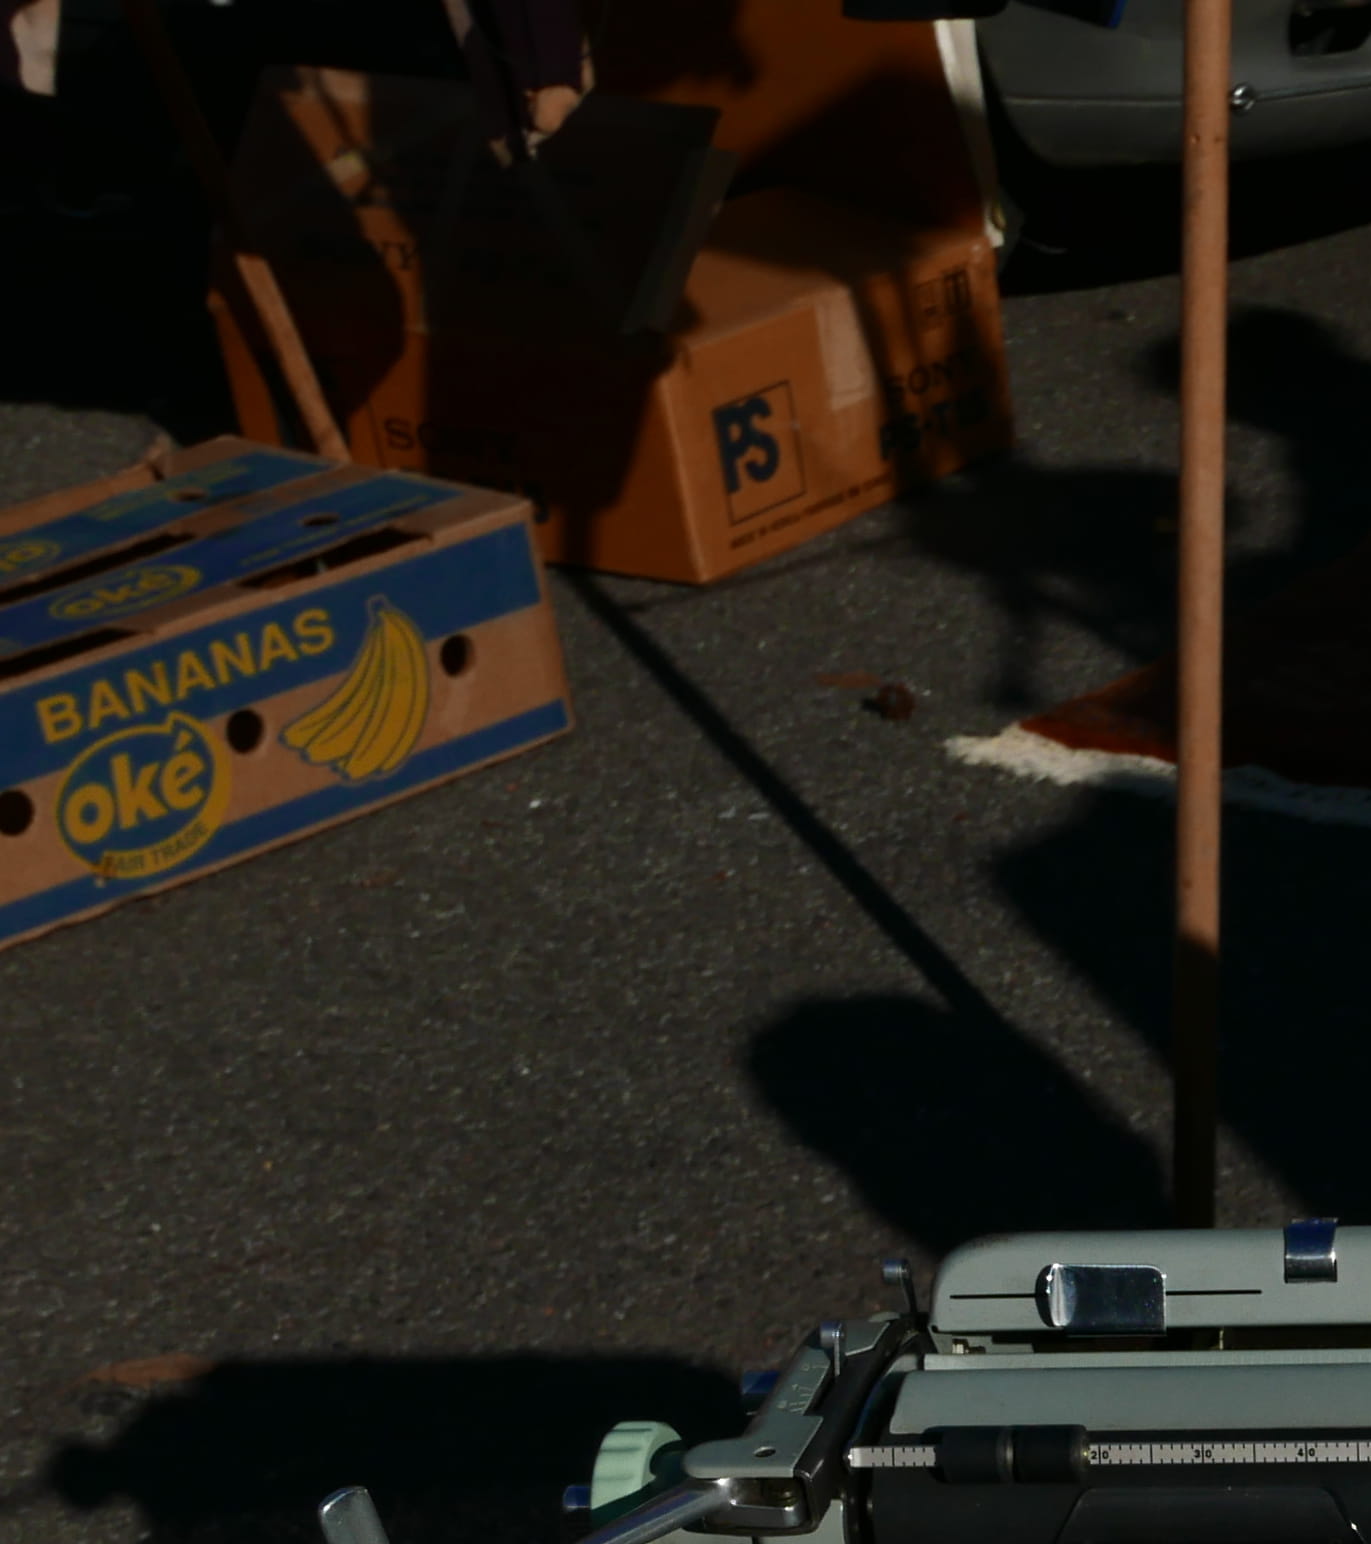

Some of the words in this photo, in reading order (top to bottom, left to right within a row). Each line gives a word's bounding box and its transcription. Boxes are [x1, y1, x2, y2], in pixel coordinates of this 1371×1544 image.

[713, 397, 780, 493] PS
[36, 609, 334, 743] BANANAS
[64, 734, 206, 842] oké
[1090, 1450, 1110, 1460] 20
[1193, 1449, 1213, 1460] 30
[1297, 1448, 1316, 1458] 40
